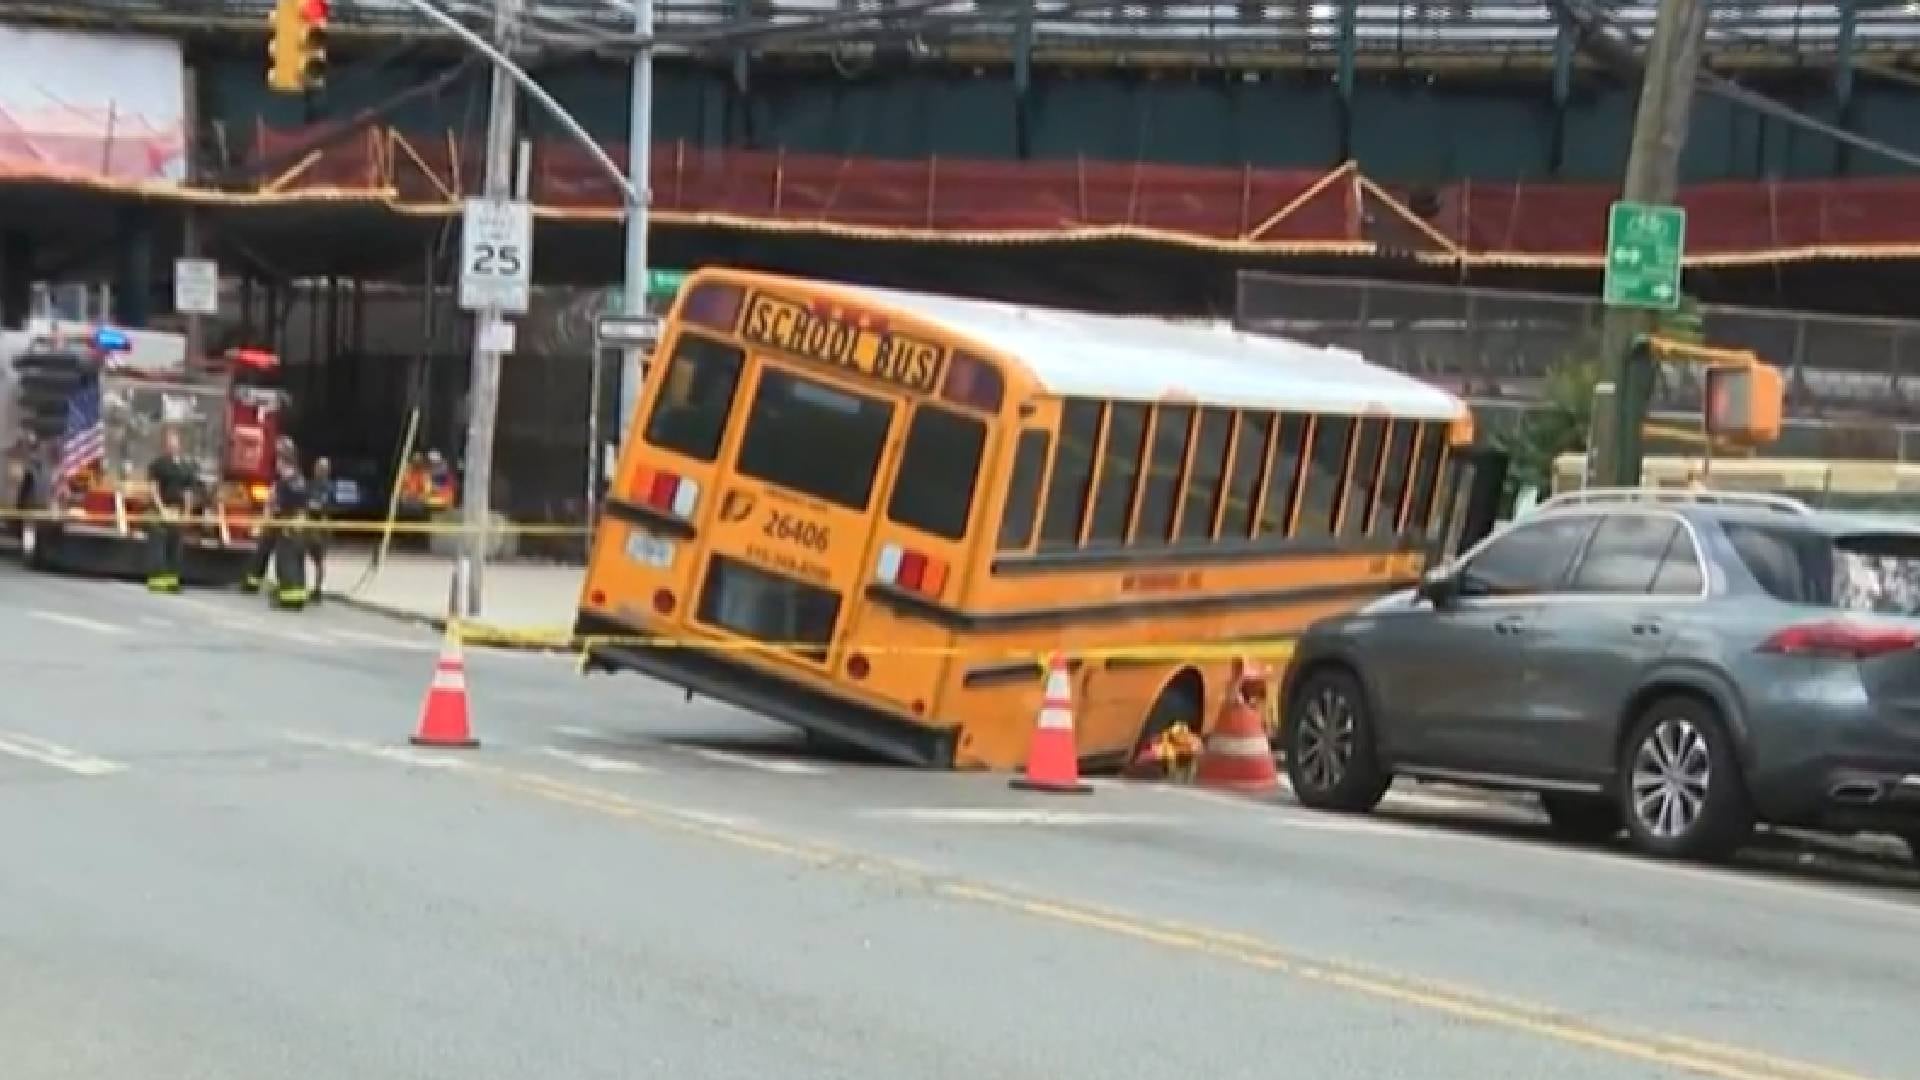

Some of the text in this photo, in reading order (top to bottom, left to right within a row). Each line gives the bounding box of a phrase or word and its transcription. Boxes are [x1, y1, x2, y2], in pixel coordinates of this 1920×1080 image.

[472, 243, 520, 274] 25
[749, 300, 936, 392] SCHOOL BUS
[762, 509, 829, 553] 26406
